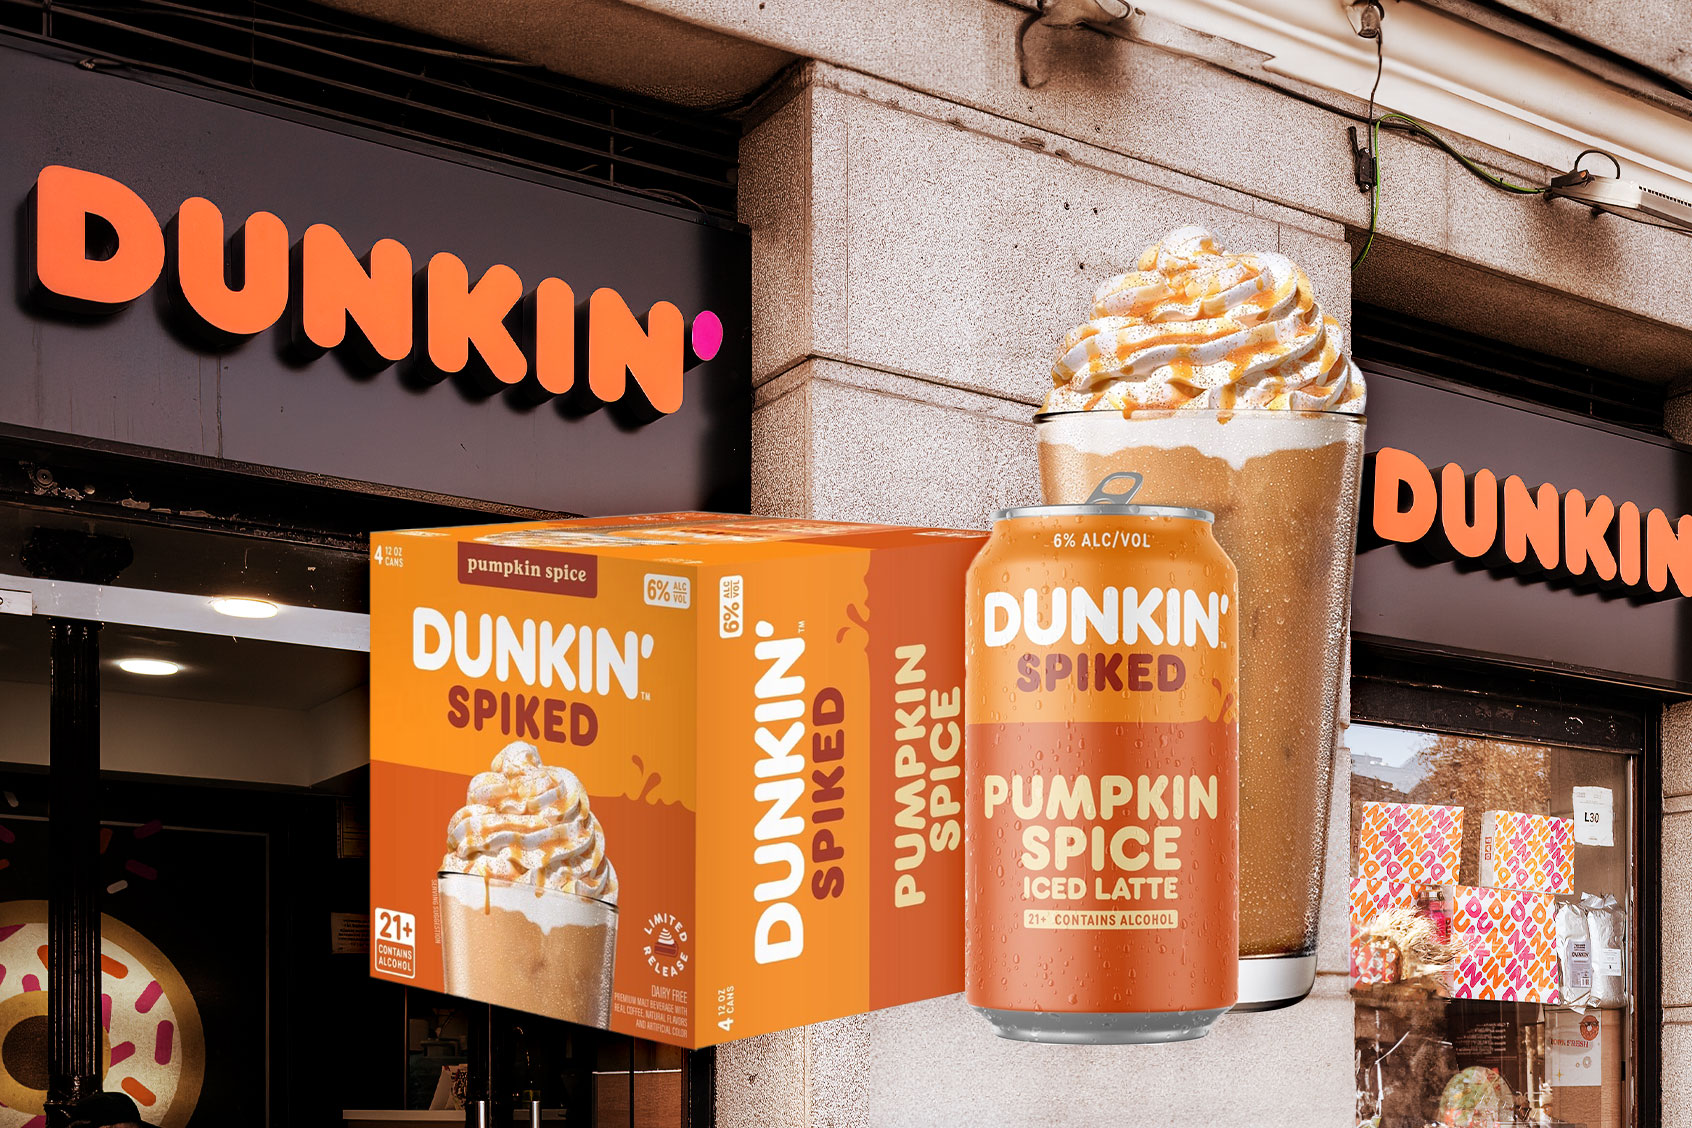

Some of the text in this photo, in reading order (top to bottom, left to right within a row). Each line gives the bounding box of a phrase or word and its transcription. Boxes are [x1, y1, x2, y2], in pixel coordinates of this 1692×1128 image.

[37, 165, 723, 414] DUNKIN'
[385, 546, 402, 557] 12 OZ
[1053, 531, 1151, 549] 6% ALC/VOL
[374, 544, 383, 565] 4
[385, 556, 403, 567] CANS
[467, 556, 587, 582] pumpkin spice
[647, 578, 670, 602] 6%
[673, 581, 687, 592] ALC
[673, 594, 687, 605] VOL
[723, 602, 740, 633] 6%
[984, 586, 1229, 649] DUNKIN'
[413, 606, 654, 699] DUNKIN'
[1016, 653, 1186, 692] SPIKED
[447, 685, 598, 746] SPIKED
[894, 643, 926, 908] PUMPKIN
[929, 686, 961, 852] SPICE
[754, 620, 805, 964] DUNKIN'
[811, 687, 845, 900] SPIKED
[984, 774, 1218, 820] PUMPKIN
[1584, 812, 1600, 823] L30
[1021, 825, 1182, 872] SPICE
[1023, 876, 1178, 900] ICED LATTE
[380, 912, 412, 940] 21+
[644, 913, 687, 942] LIMITED
[1028, 914, 1174, 926] 21+ CONTAINS ALCOHOL
[378, 944, 412, 960] CONTAINS
[378, 956, 411, 972] ALCOHOL
[643, 946, 688, 977] RELEASE
[614, 992, 636, 1004] PREMIUM
[650, 1000, 674, 1013] BEVERAGE
[675, 1005, 687, 1016] WITH
[651, 984, 687, 1004] DAIRY FREE
[718, 988, 725, 1016] 12 OZ
[727, 985, 735, 1014] CANS
[614, 1003, 626, 1013] REAL
[645, 1010, 666, 1022] NATURAL
[666, 1014, 687, 1027] FLAVORS
[717, 1018, 734, 1031] 4
[636, 1019, 687, 1038] AND ARTIFICIAL COLOR
